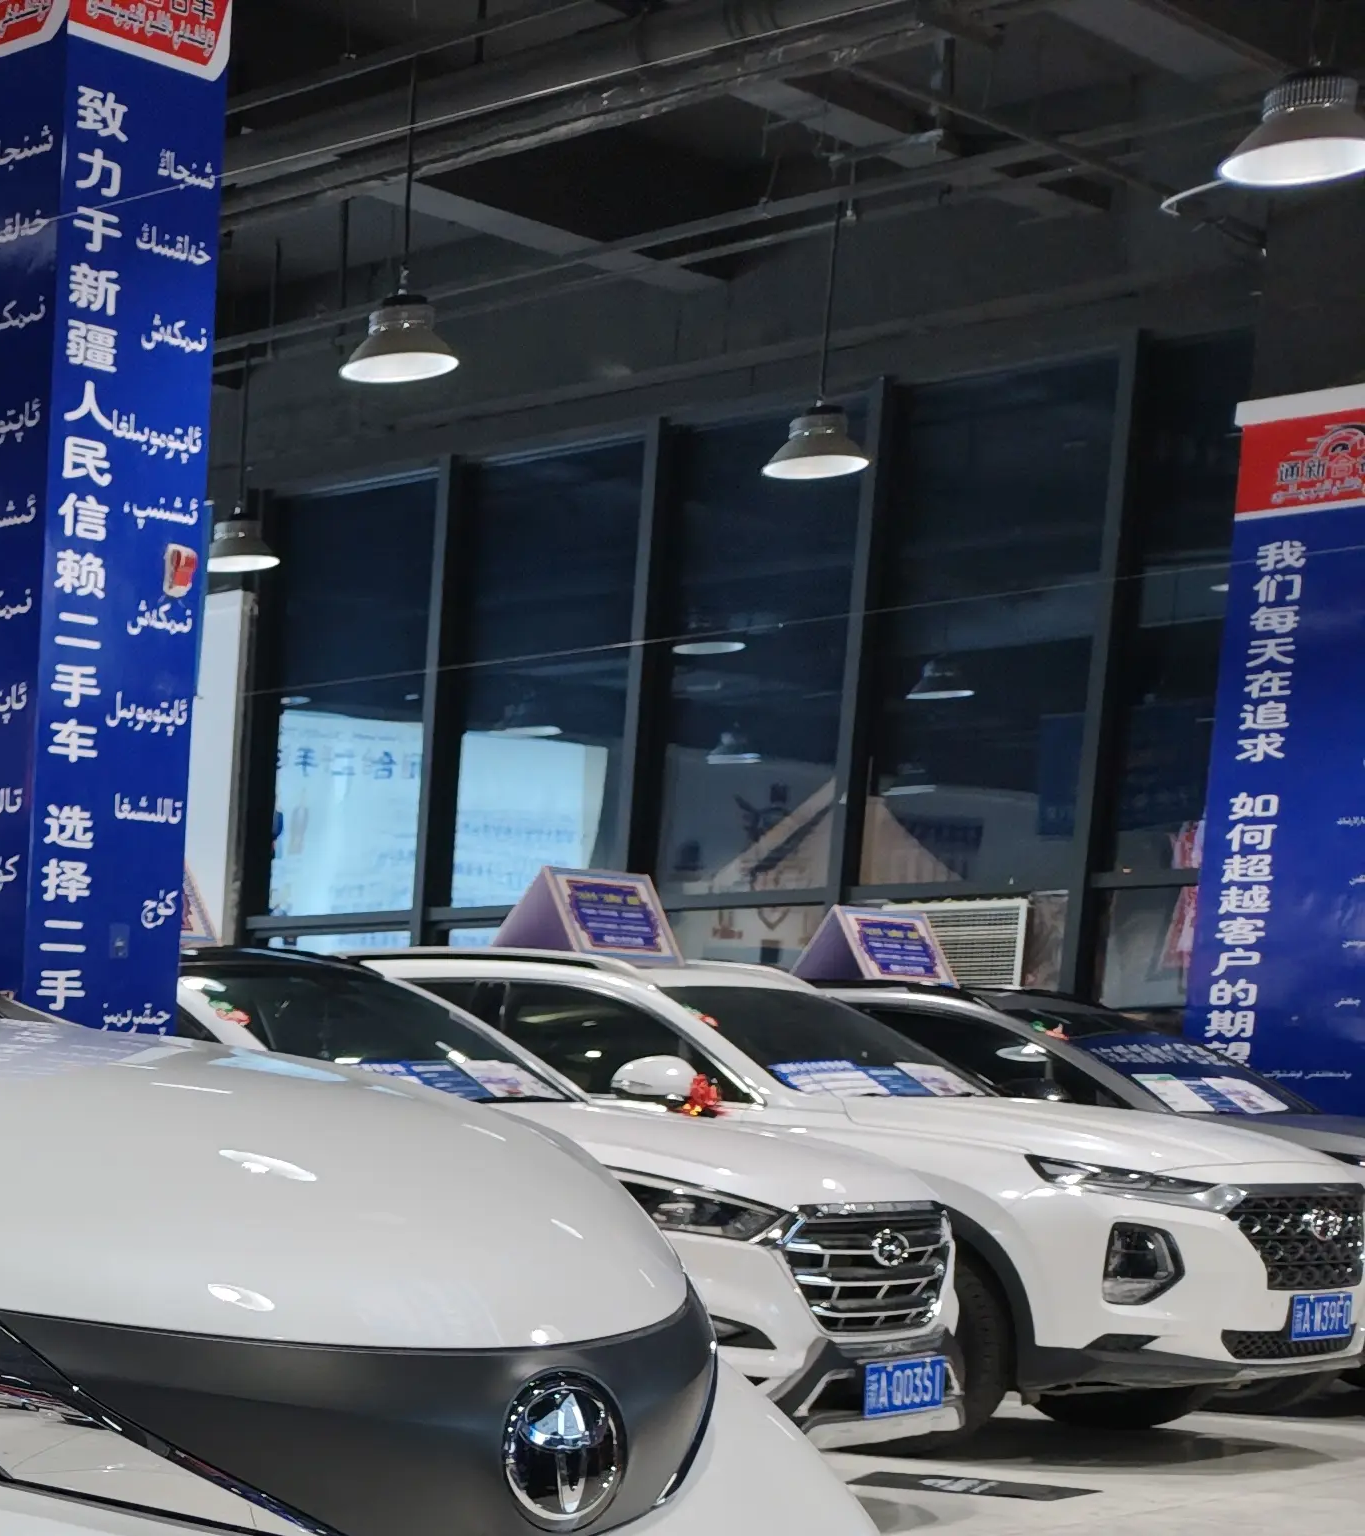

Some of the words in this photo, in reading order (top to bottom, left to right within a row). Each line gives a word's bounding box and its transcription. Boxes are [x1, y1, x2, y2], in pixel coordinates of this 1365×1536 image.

[1275, 453, 1365, 486] 通新合
[1235, 538, 1307, 763] 我们每天在追求
